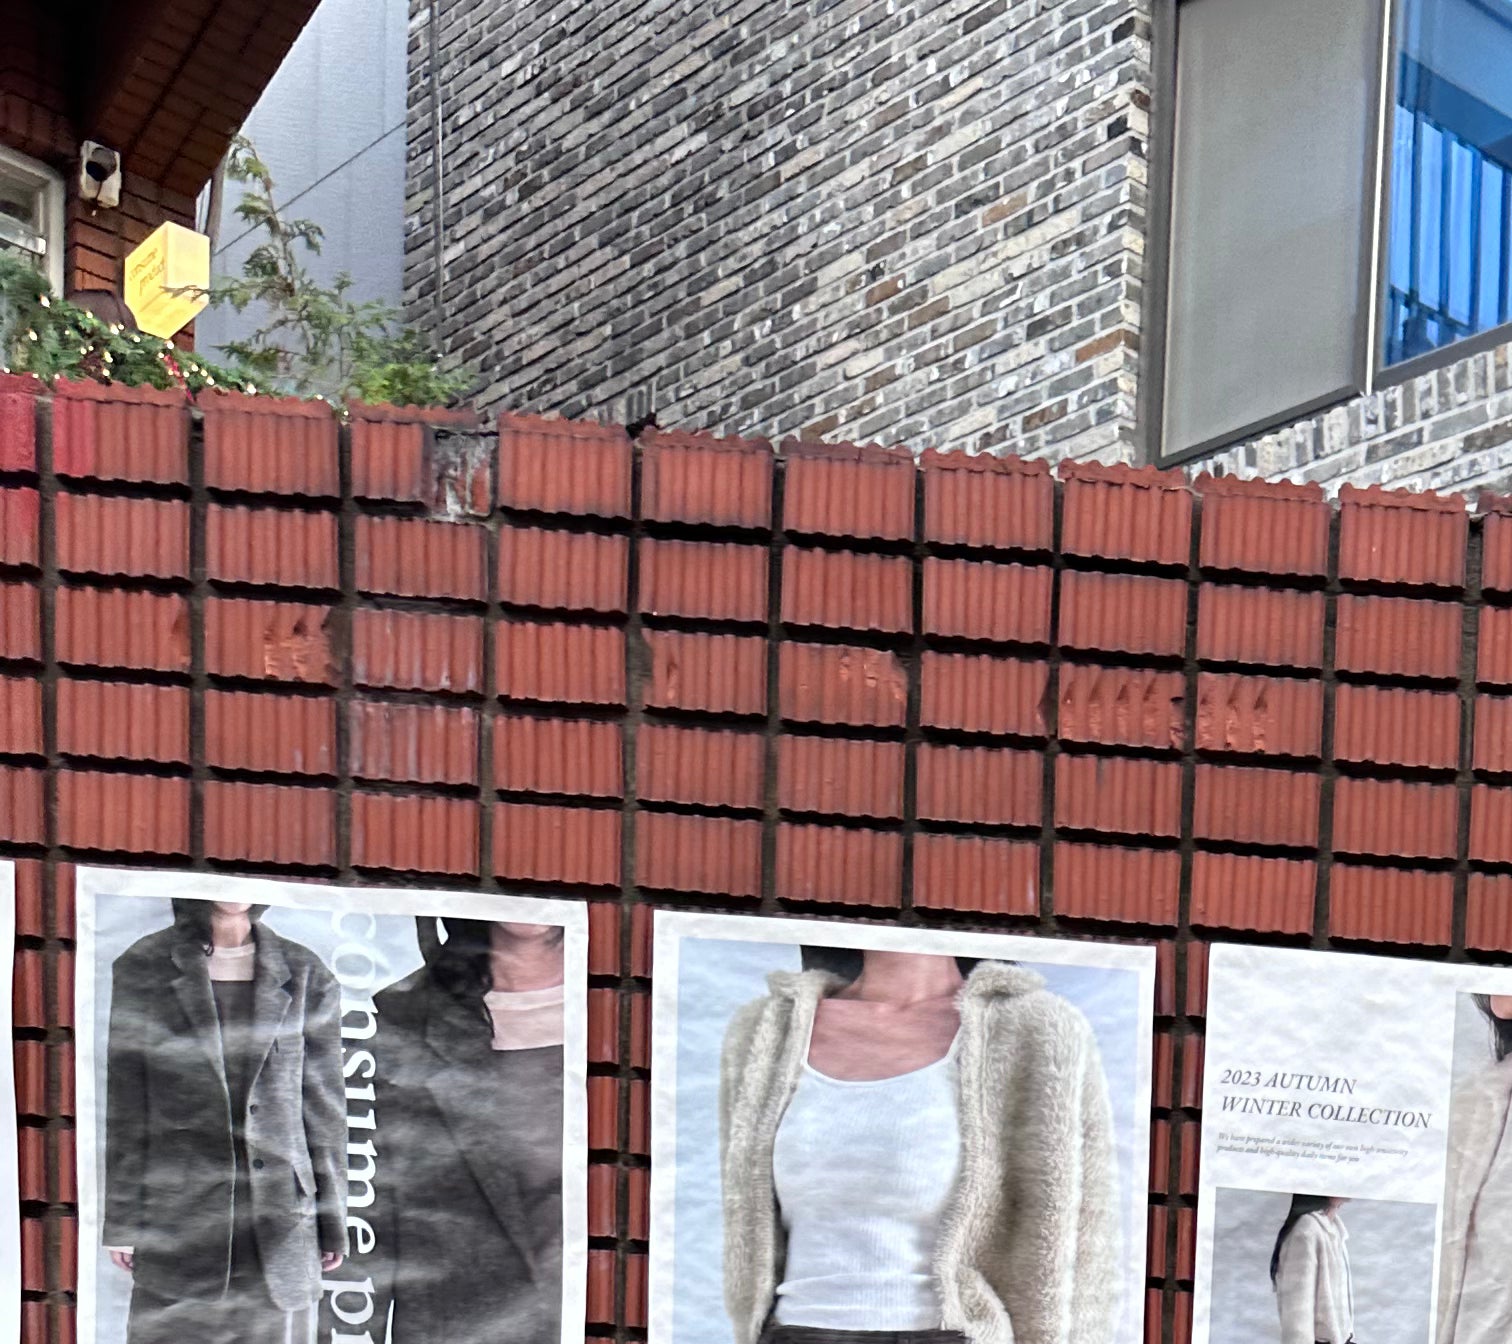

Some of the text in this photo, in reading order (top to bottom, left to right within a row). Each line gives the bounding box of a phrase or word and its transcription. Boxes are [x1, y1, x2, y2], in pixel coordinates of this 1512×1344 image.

[1220, 1068, 1358, 1095] 2023 AUTUMN
[1221, 1095, 1432, 1130] WINTER COLLECTION
